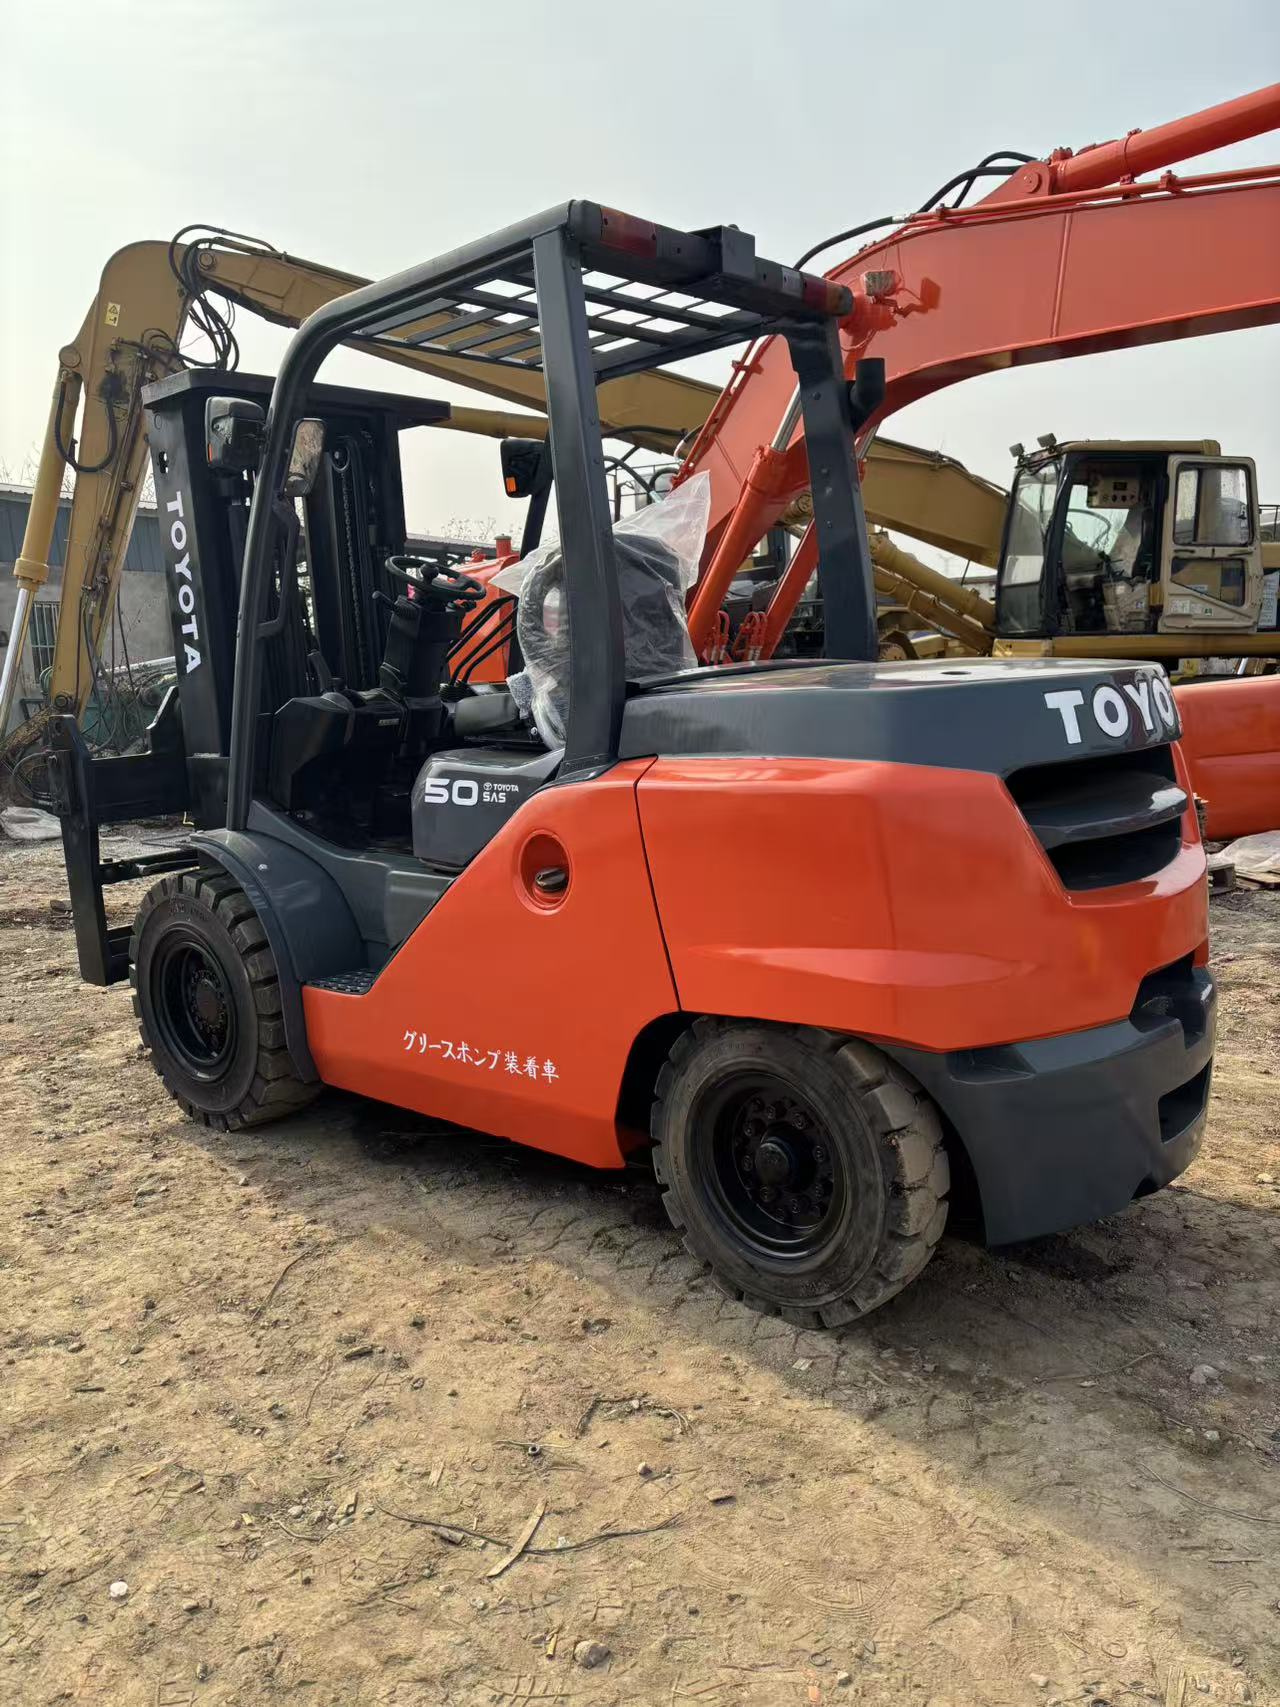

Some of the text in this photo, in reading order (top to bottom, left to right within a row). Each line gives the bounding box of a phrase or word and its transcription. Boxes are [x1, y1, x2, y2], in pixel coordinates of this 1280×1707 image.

[166, 491, 202, 674] TOYOTA
[1044, 677, 1174, 744] TOYO
[424, 777, 479, 806] 50
[482, 791, 506, 803] SAS
[493, 783, 519, 792] TOYOTA
